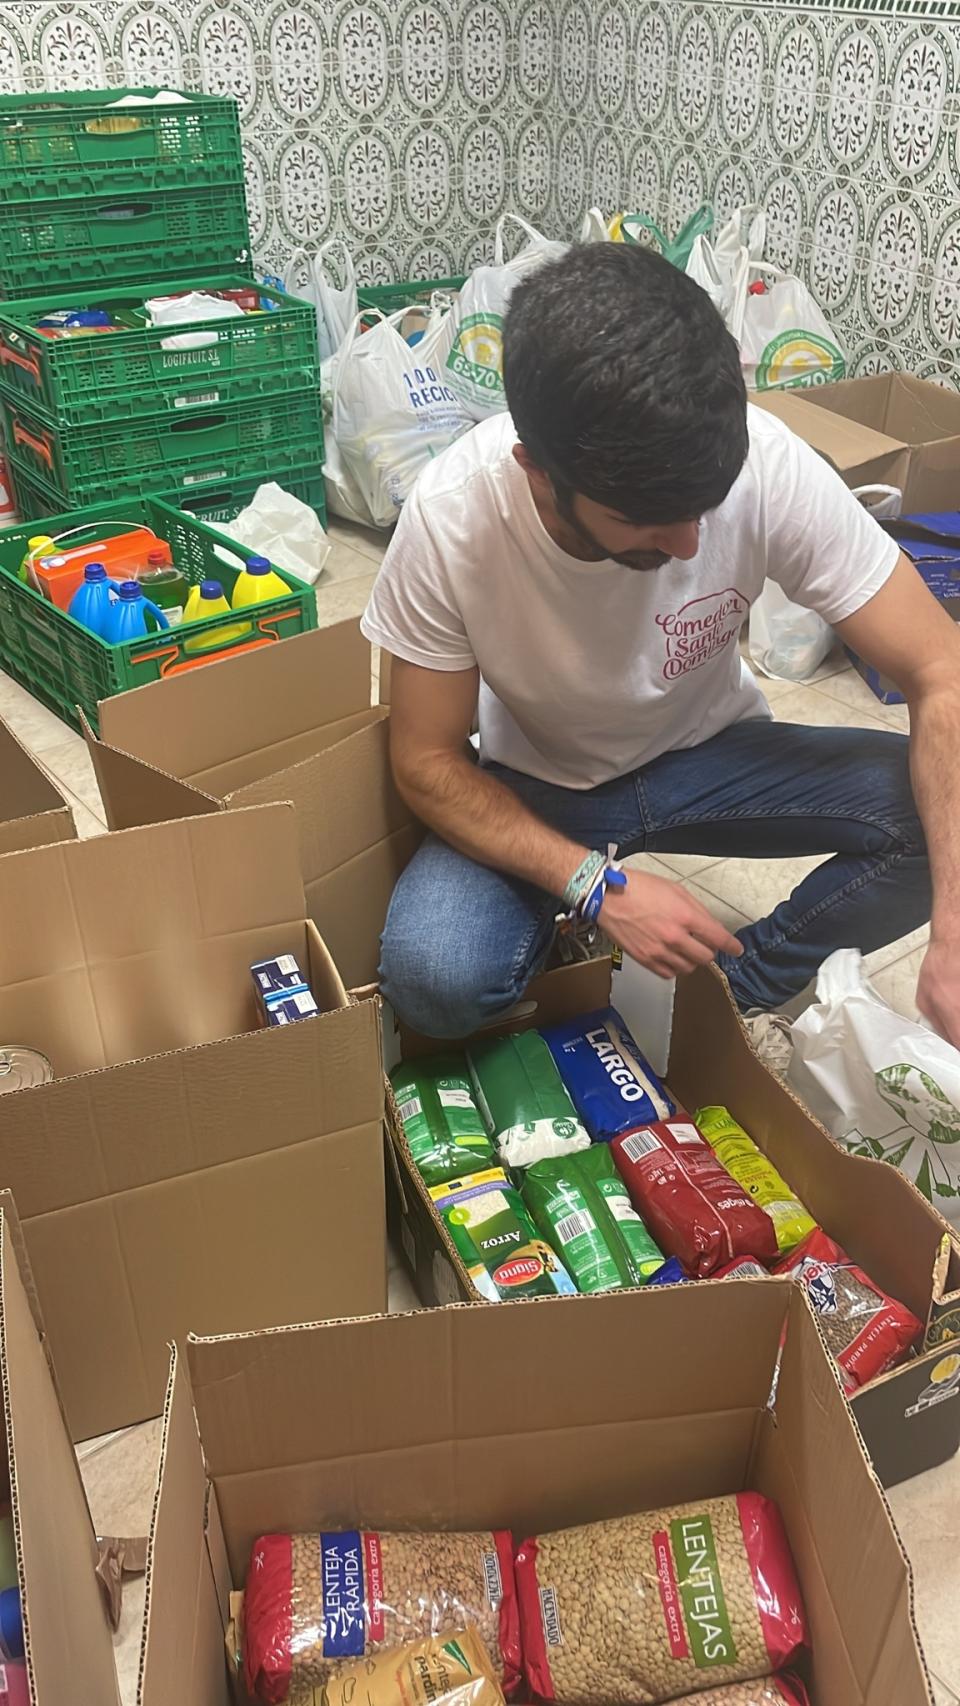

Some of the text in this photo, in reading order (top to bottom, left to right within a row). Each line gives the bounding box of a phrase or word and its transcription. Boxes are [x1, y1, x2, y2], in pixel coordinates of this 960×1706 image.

[403, 367, 437, 388] 100
[655, 598, 742, 637] Comedor
[675, 622, 724, 659] Santo
[585, 1027, 644, 1102] LARGO
[480, 1230, 521, 1249] Arroz
[498, 1261, 539, 1280] Signo
[866, 1314, 896, 1342] LENTEJA
[844, 1344, 869, 1369] PARDIN
[369, 1539, 379, 1565] extra
[325, 1546, 343, 1620] LENTEJA
[342, 1548, 360, 1612] RÁPIDA
[658, 1545, 681, 1642] categoría extra
[682, 1522, 727, 1659] LENTEJAS
[541, 1588, 560, 1645] HACENDADO
